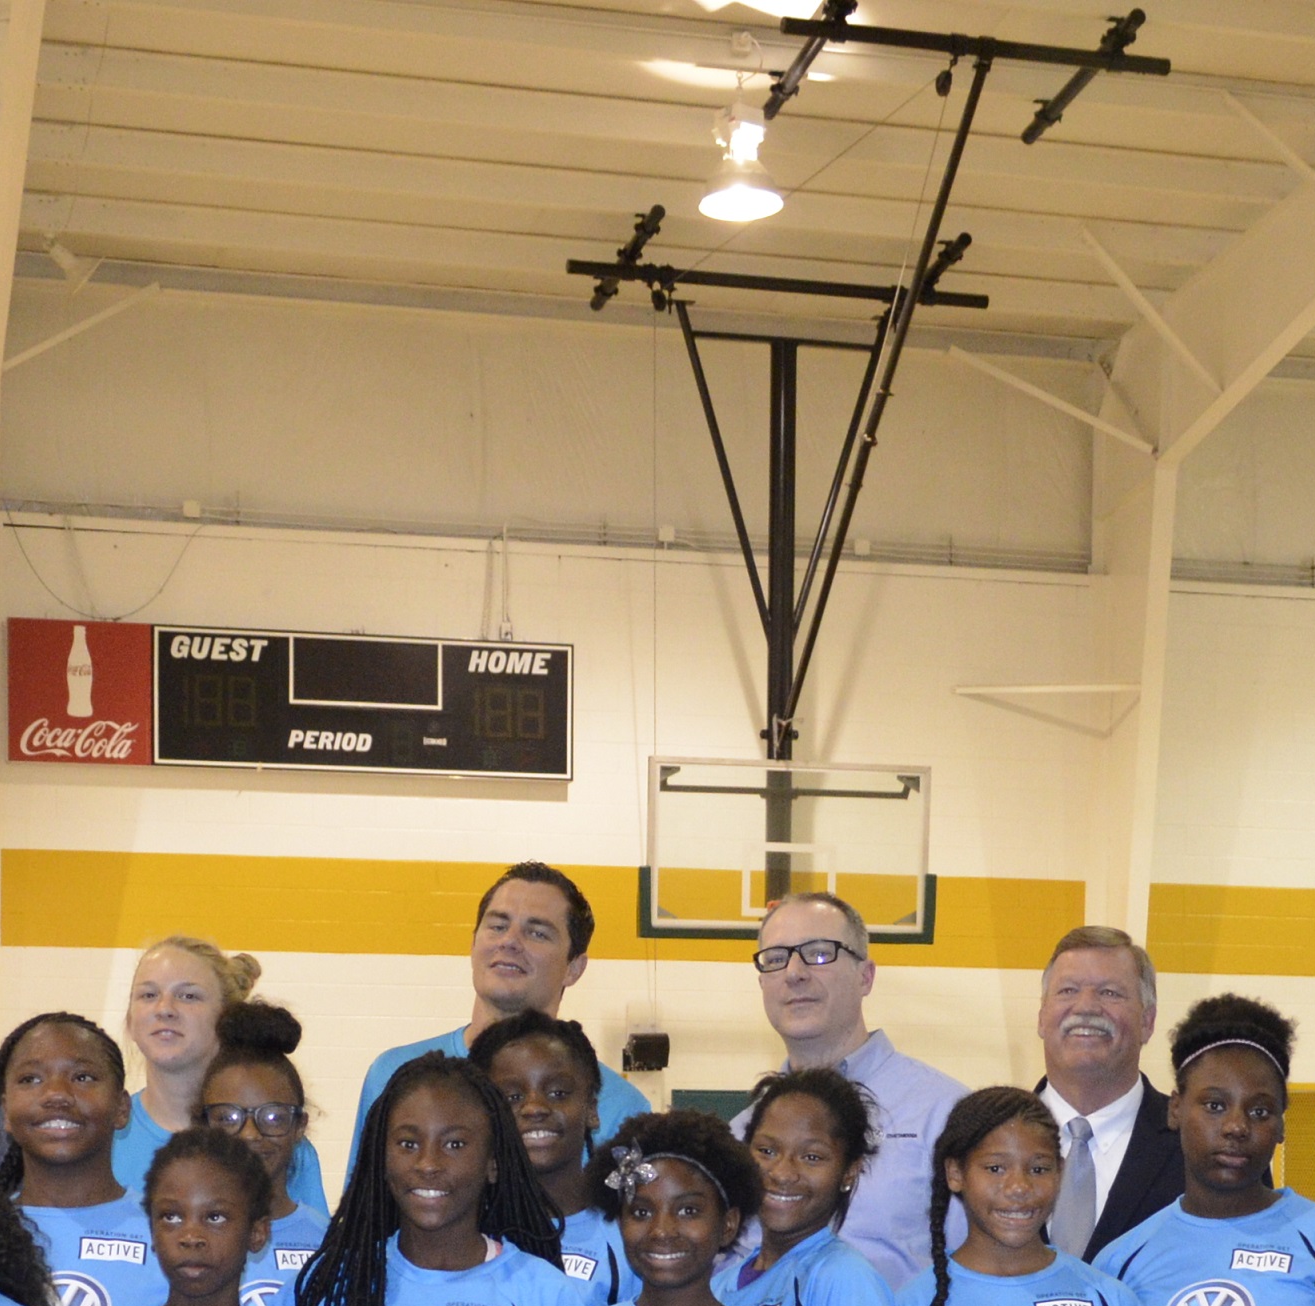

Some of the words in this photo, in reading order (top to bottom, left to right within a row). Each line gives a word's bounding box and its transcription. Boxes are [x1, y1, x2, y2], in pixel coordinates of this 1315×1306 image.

[171, 633, 268, 663] GUEST
[468, 649, 552, 676] HOME
[19, 717, 139, 759] Coca-Cola
[287, 729, 373, 753] PERIOD
[86, 1242, 141, 1260] ACTIVE
[1236, 1254, 1287, 1269] ACTIVE
[563, 1258, 592, 1275] TIVE
